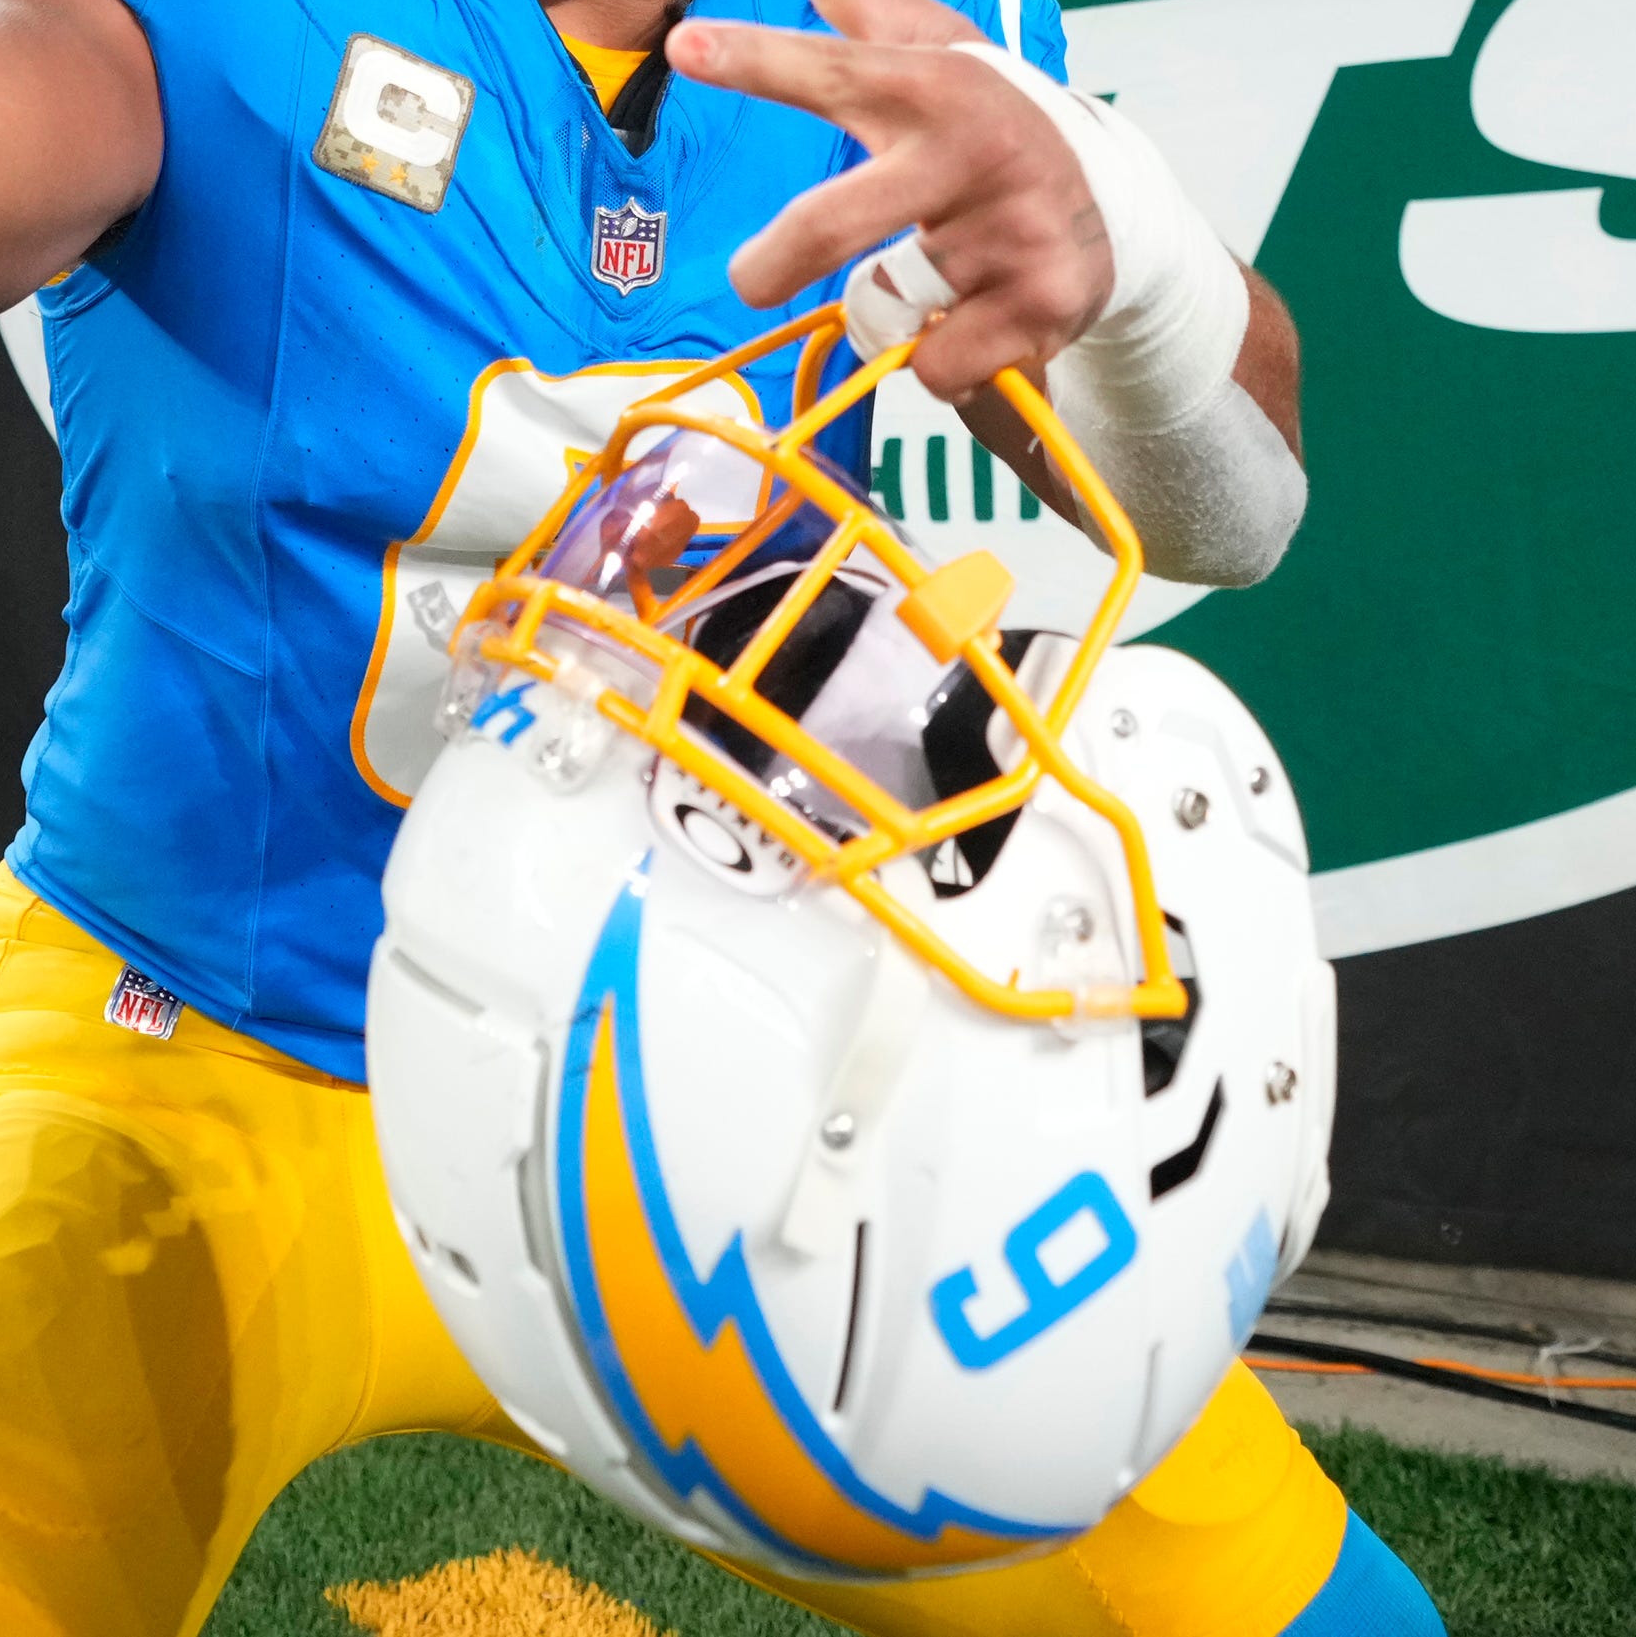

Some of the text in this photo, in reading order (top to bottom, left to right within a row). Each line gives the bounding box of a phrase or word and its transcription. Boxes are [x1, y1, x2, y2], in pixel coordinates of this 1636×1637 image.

[343, 49, 462, 168] C
[603, 239, 652, 277] NFL
[116, 991, 164, 1031] NFL
